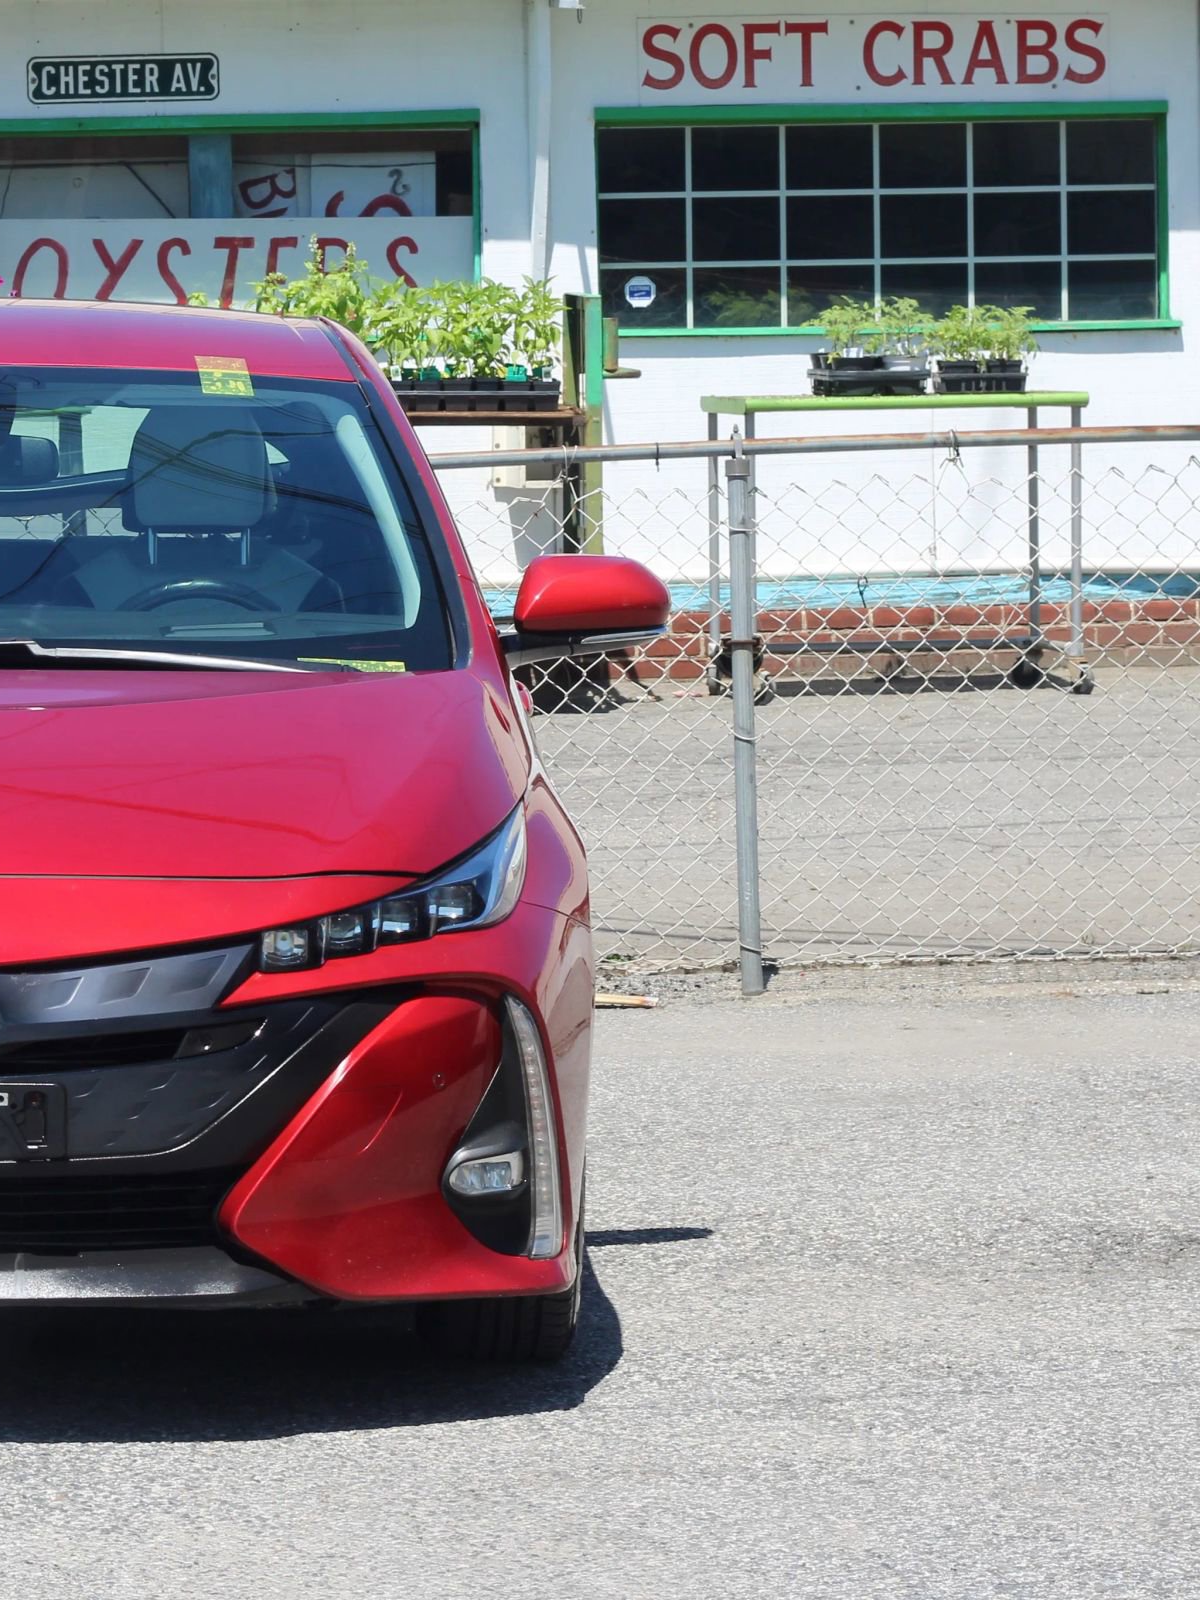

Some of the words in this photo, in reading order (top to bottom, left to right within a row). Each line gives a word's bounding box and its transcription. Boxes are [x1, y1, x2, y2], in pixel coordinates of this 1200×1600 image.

[41, 63, 160, 96] CHESTER
[170, 62, 206, 93] AV.
[641, 20, 829, 90] SOFT
[863, 19, 1107, 87] CRABS
